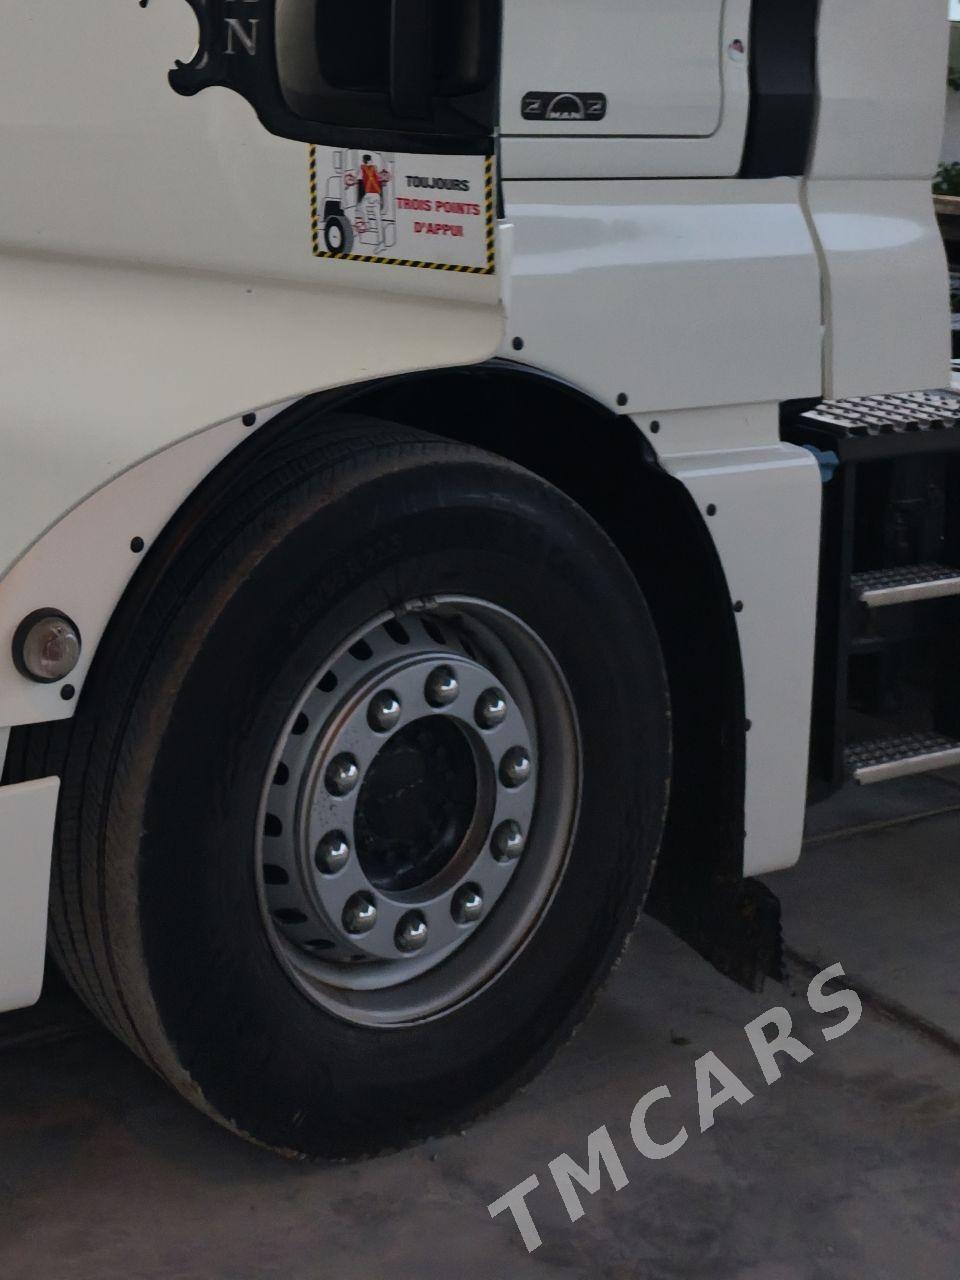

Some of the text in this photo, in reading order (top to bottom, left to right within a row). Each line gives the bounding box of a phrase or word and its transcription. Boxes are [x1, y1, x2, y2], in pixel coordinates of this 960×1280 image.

[405, 175, 470, 191] TOUJOURS
[395, 197, 481, 216] TROIS POINTS
[414, 221, 464, 236] D'APPUI
